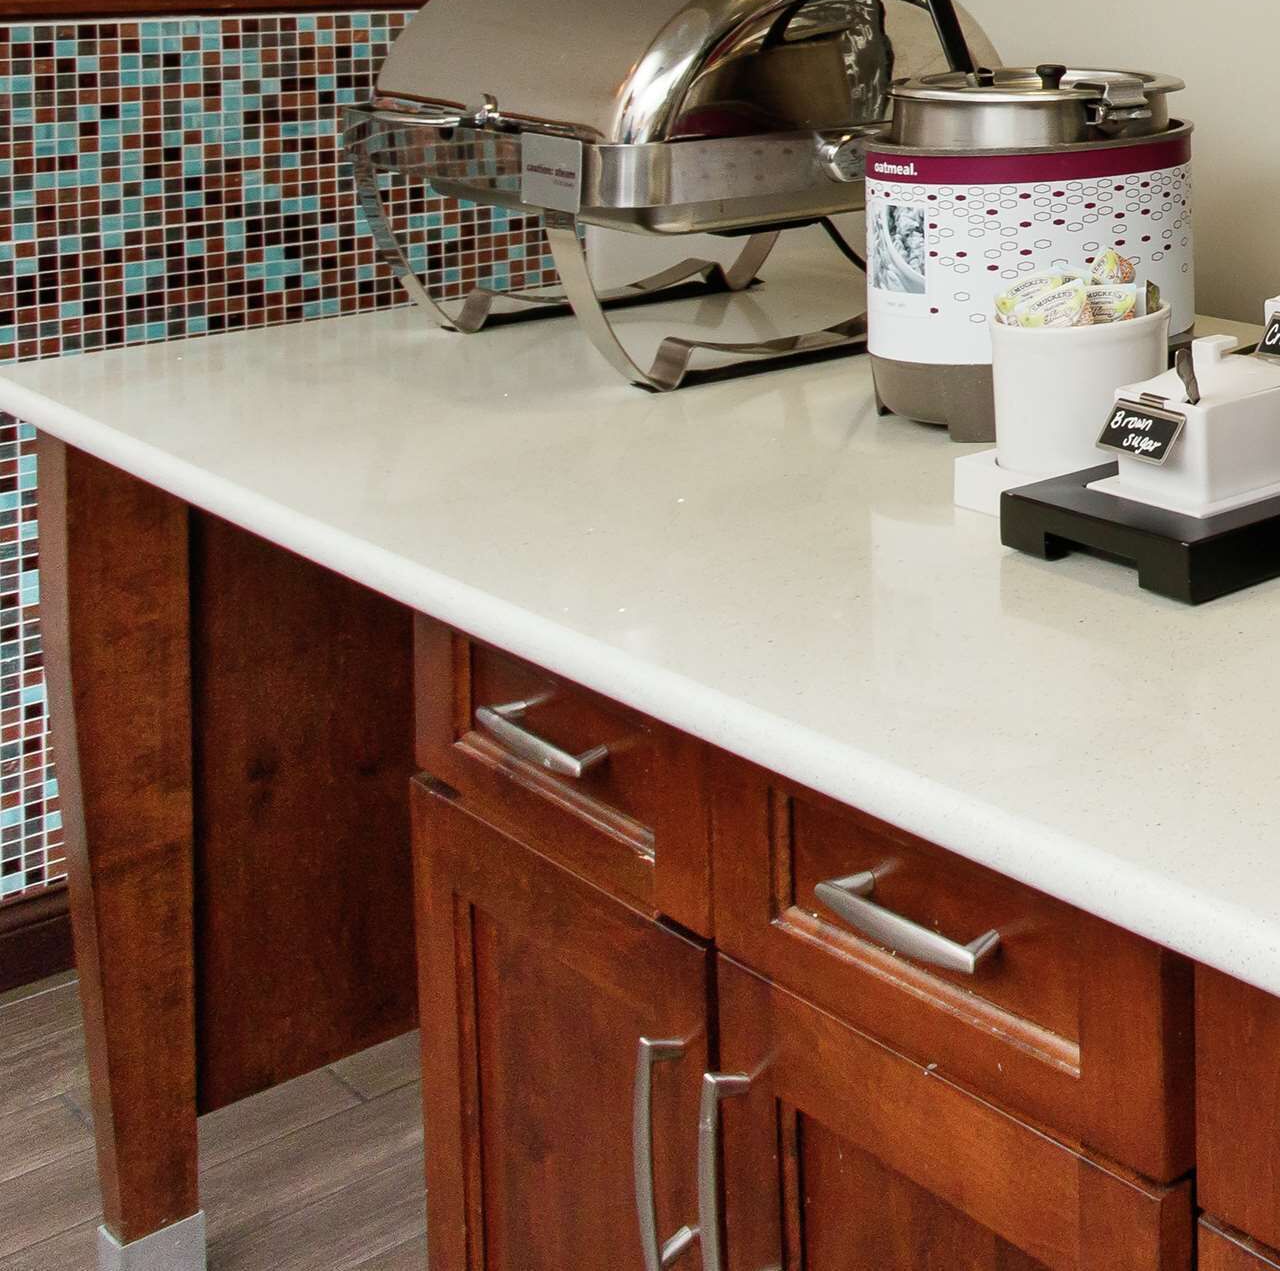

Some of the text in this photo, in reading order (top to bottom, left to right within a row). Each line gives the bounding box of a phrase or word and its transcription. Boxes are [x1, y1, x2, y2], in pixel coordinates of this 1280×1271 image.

[874, 161, 918, 176] oatmeal.
[1110, 410, 1153, 431] Brown
[1122, 433, 1162, 454] sugar
